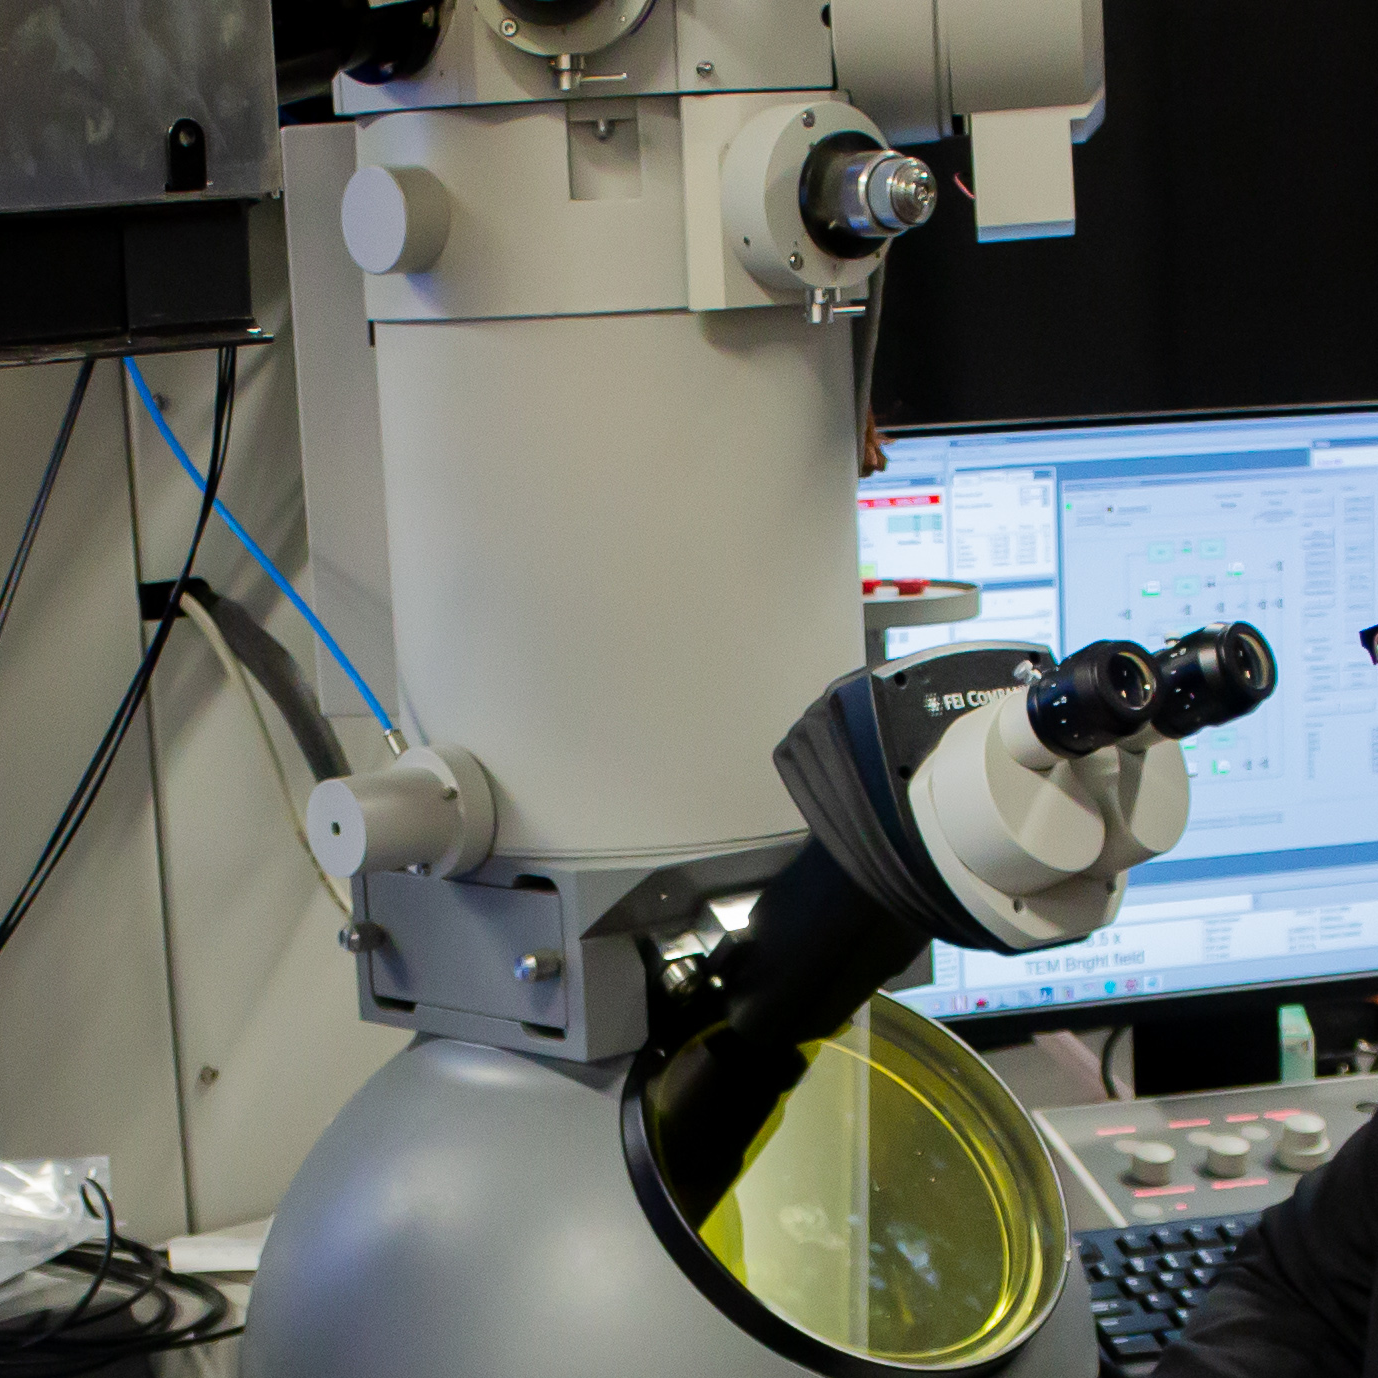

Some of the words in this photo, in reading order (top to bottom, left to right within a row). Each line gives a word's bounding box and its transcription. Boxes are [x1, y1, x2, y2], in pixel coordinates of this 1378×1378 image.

[942, 692, 966, 711] FEI
[1024, 958, 1062, 977] TEM
[1065, 953, 1110, 975] Bright
[1113, 949, 1146, 967] field
